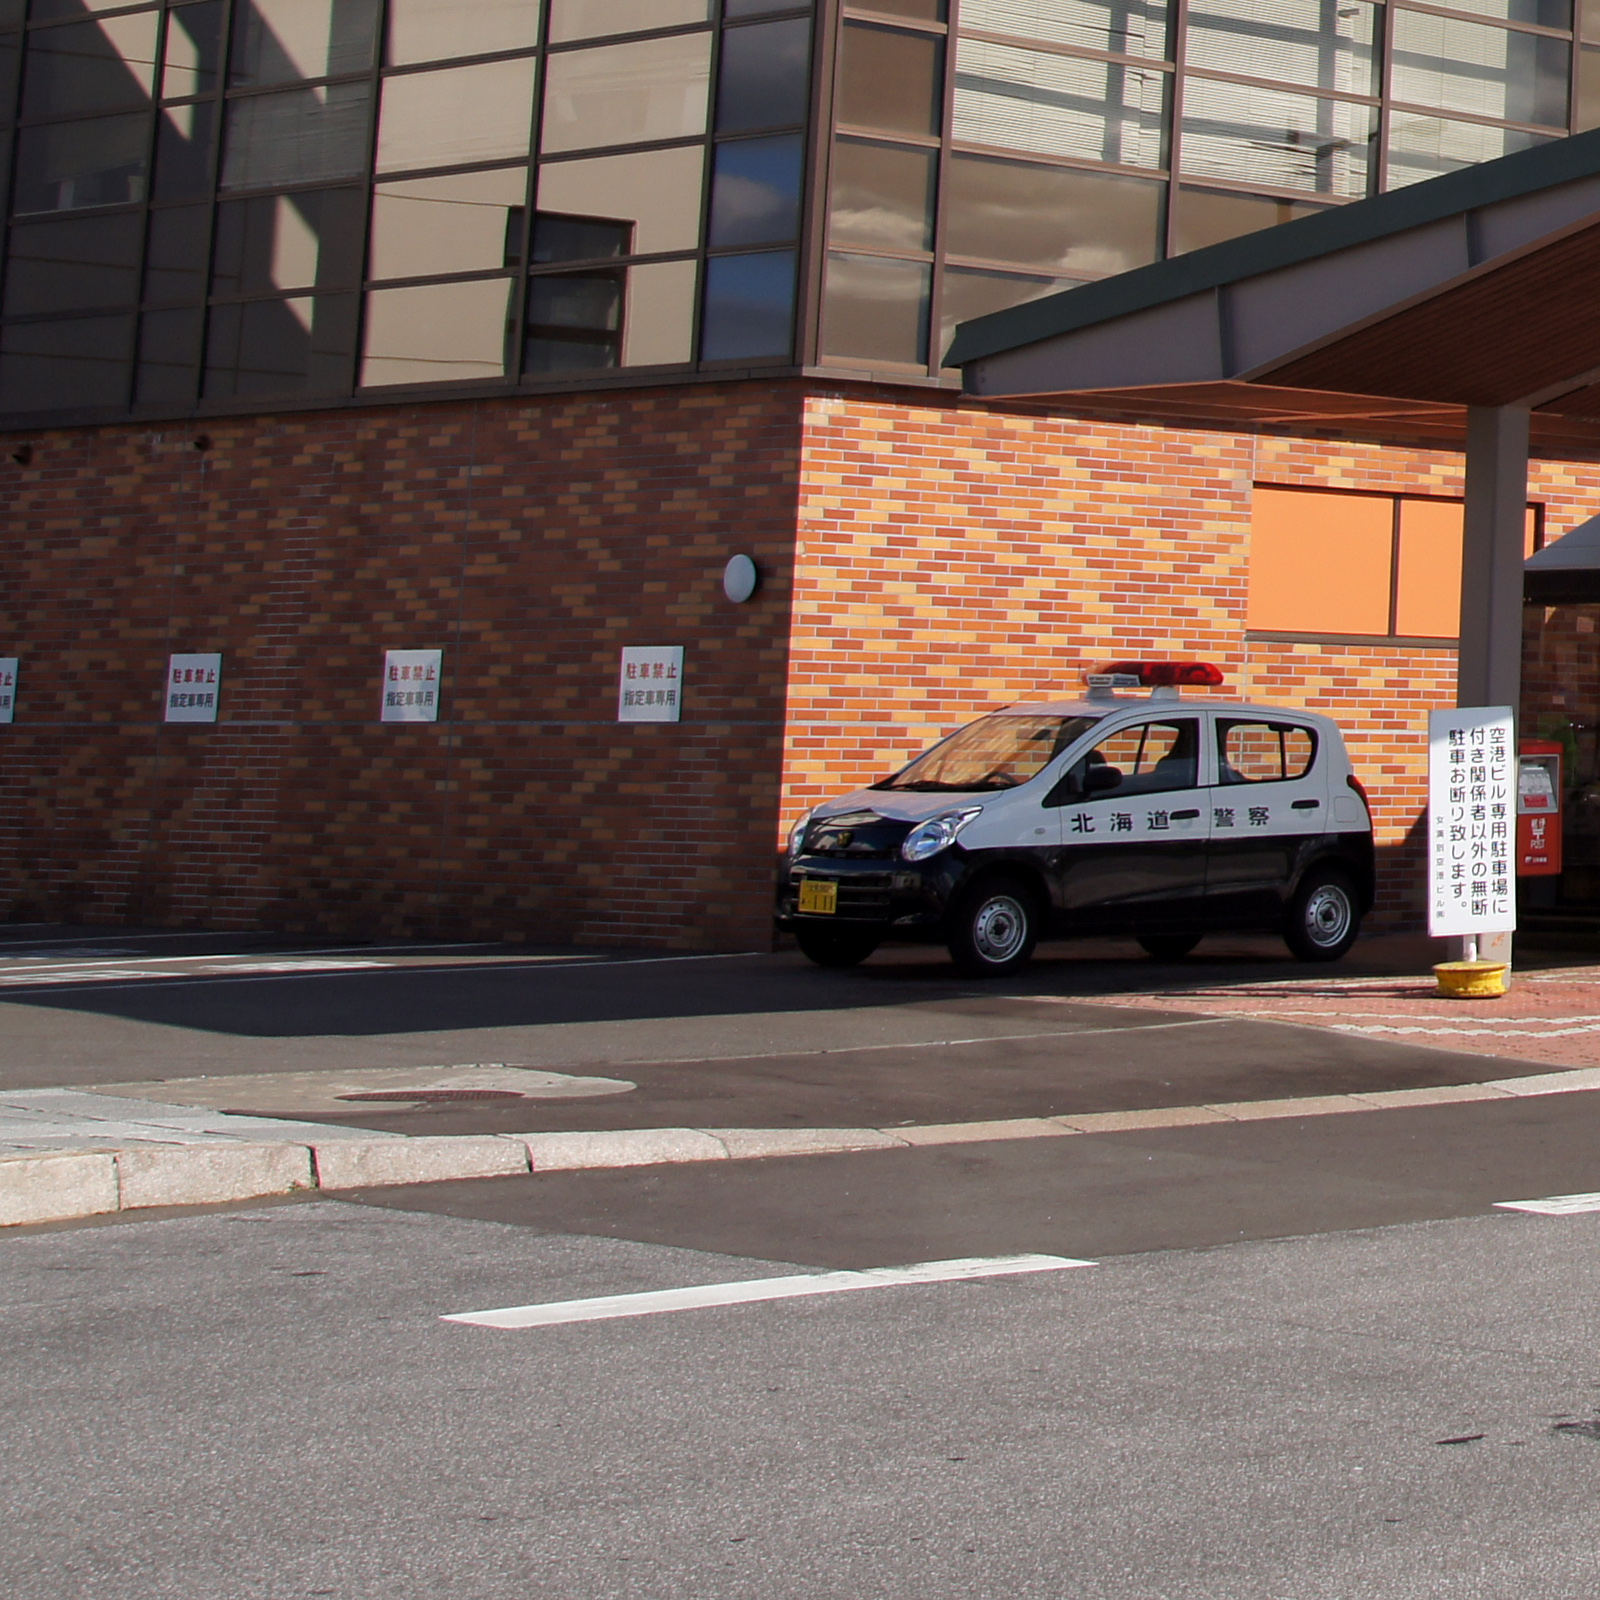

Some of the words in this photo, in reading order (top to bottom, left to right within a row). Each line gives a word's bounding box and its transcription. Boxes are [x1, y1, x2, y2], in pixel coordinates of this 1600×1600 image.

[172, 668, 216, 684] 駐車禁止
[388, 664, 436, 681] 駐車禁止
[626, 662, 677, 679] 駐車禁止
[169, 692, 214, 708] 指定車専用
[386, 691, 434, 707] 指定車専用
[623, 689, 676, 706] 指定車専用
[1070, 806, 1270, 834] 北海道警察
[1449, 728, 1467, 908] 駐車お断り致します。
[1469, 727, 1487, 916] 付き関係者以外の無断
[1488, 727, 1508, 914] 空港ビル専用駐車場に
